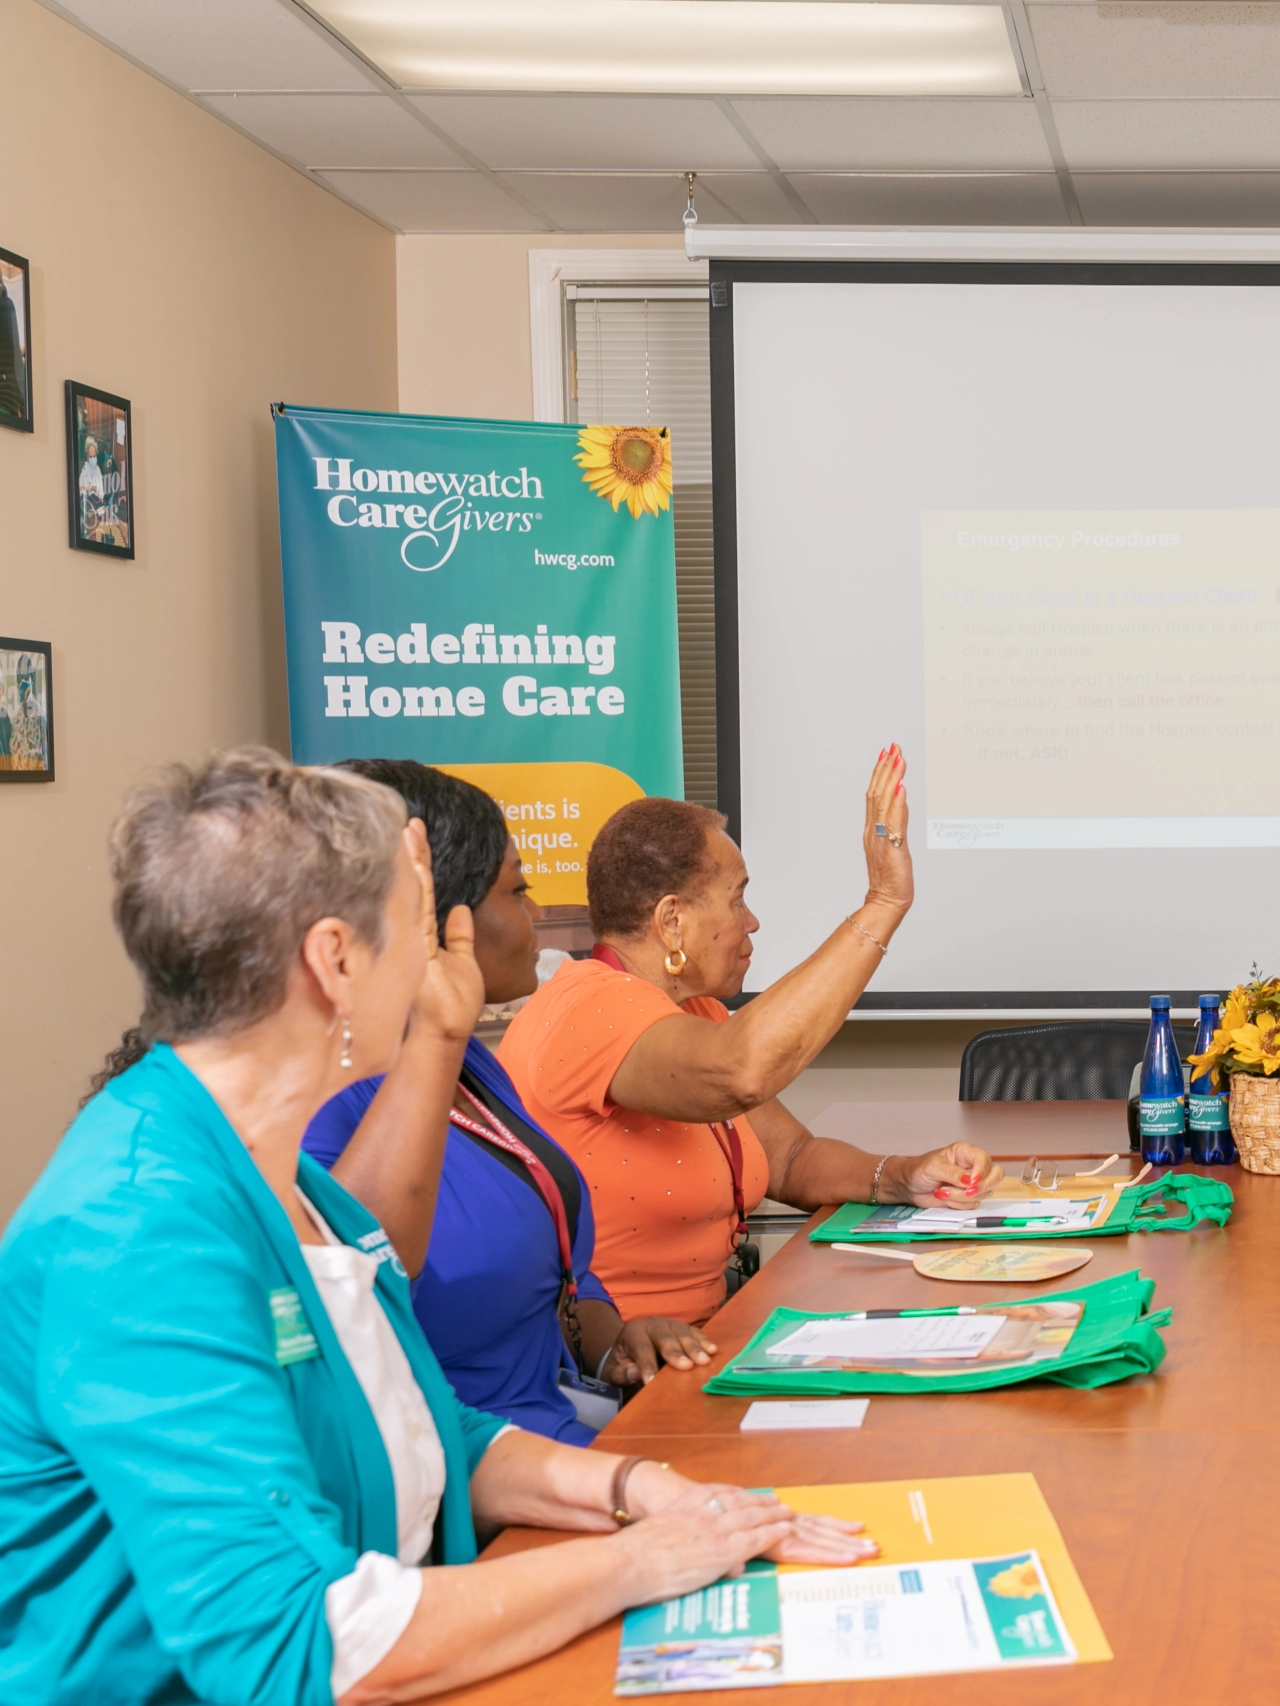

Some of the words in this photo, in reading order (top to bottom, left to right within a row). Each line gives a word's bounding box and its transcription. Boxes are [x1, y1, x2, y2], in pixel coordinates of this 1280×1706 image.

[311, 457, 545, 499] Homewatch
[957, 530, 1064, 552] Emergency
[1071, 530, 1181, 548] Procedures
[534, 549, 615, 570] hwcg.com
[1124, 588, 1198, 610] Hospice
[1204, 586, 1258, 605] Client
[321, 621, 616, 676] Redefining
[324, 675, 486, 717] Home
[502, 675, 625, 716] Care
[562, 798, 580, 819] is
[933, 820, 1004, 830] Homewatch
[556, 860, 584, 872] too.
